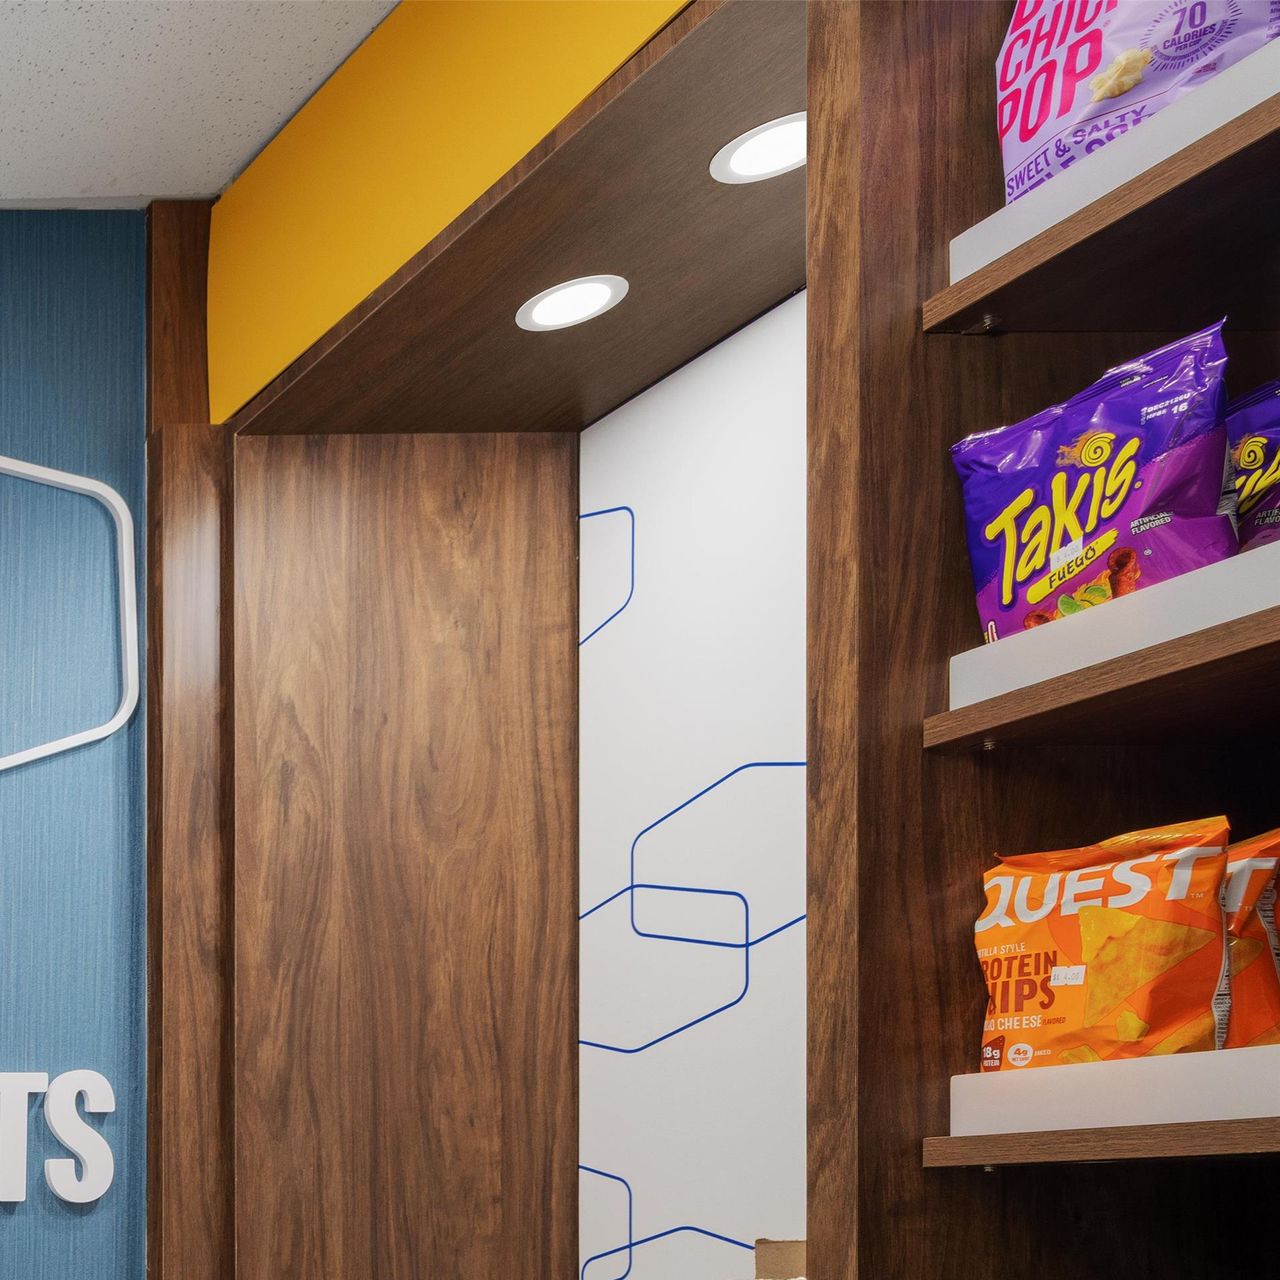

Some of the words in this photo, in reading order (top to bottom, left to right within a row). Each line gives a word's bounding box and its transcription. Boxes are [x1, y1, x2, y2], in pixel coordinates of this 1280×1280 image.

[1172, 1, 1207, 36] 70
[1163, 24, 1217, 50] CALORIES
[997, 27, 1103, 143] POP
[1006, 148, 1052, 198] SWEET
[1055, 137, 1071, 158] &
[1072, 104, 1147, 144] SALTY
[985, 437, 1144, 606] Takis
[1131, 516, 1172, 536] FLAVORED
[1048, 545, 1097, 590] FUEGO
[975, 847, 1223, 933] QUEST
[1000, 942, 1026, 955] STYLE
[997, 1014, 1042, 1031] CHEESE
[982, 1046, 1001, 1059] 18g
